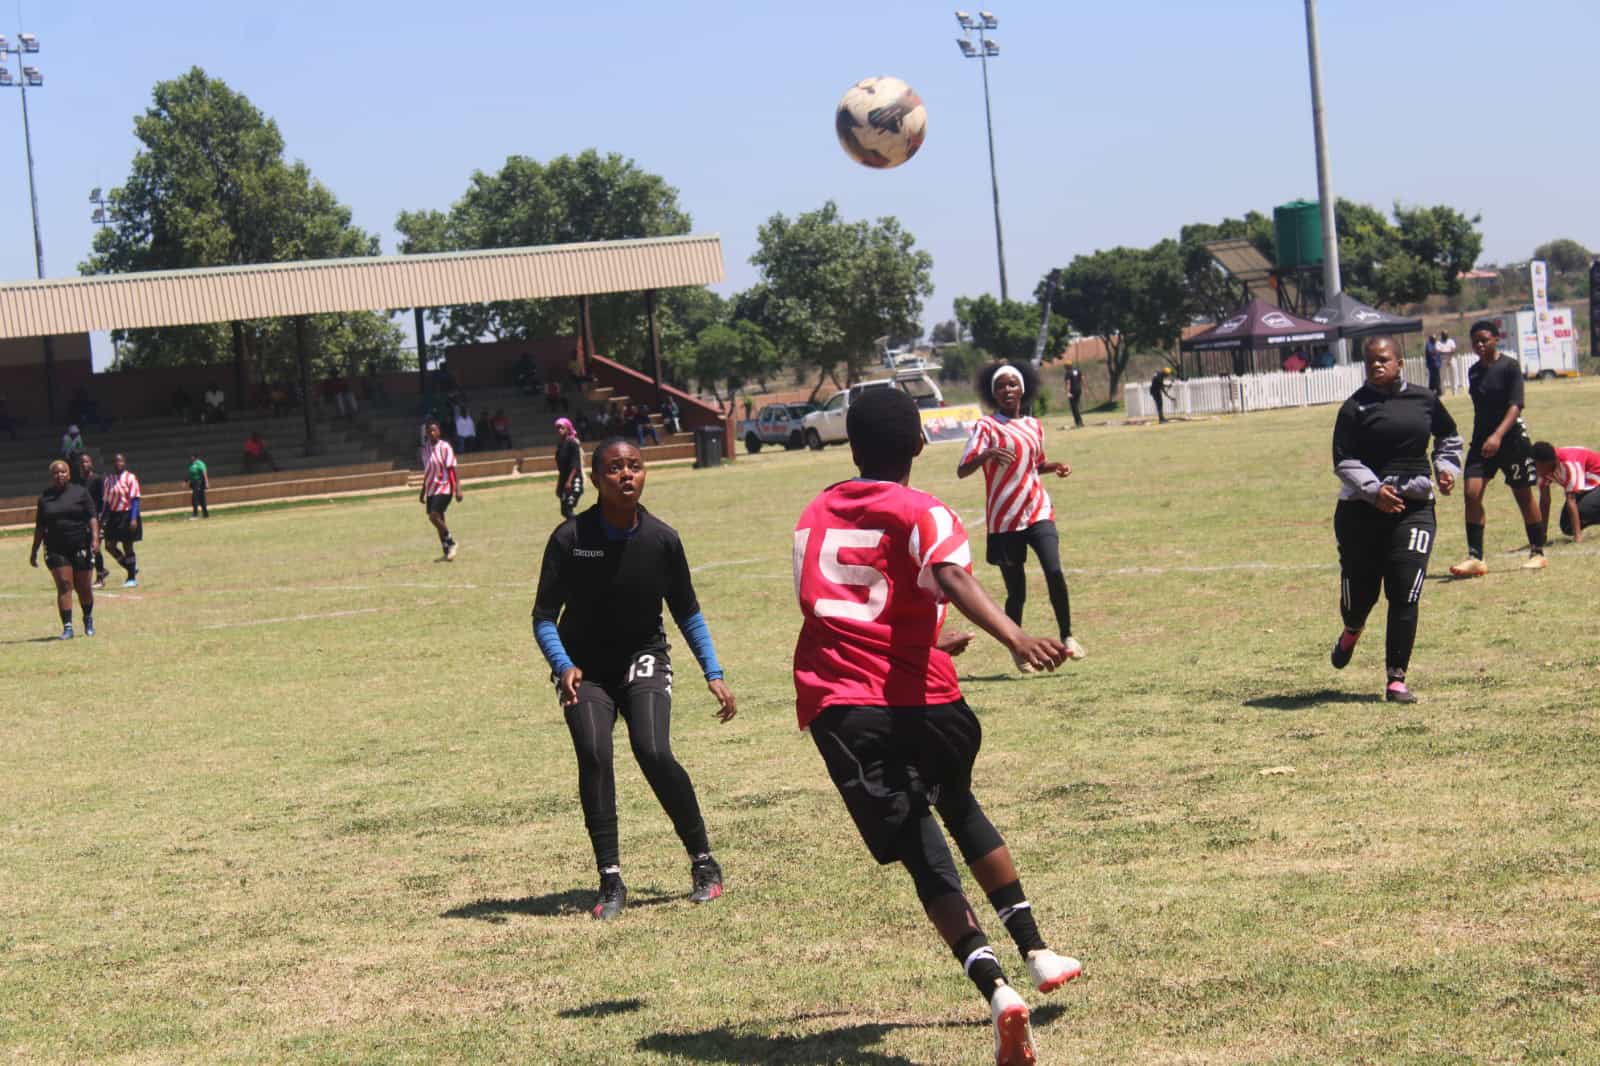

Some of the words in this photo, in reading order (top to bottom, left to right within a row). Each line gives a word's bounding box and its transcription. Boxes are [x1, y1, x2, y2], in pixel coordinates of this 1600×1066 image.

[1511, 463, 1520, 480] 2
[1407, 527, 1430, 554] 10
[793, 528, 888, 622] 15
[628, 654, 656, 682] 13
